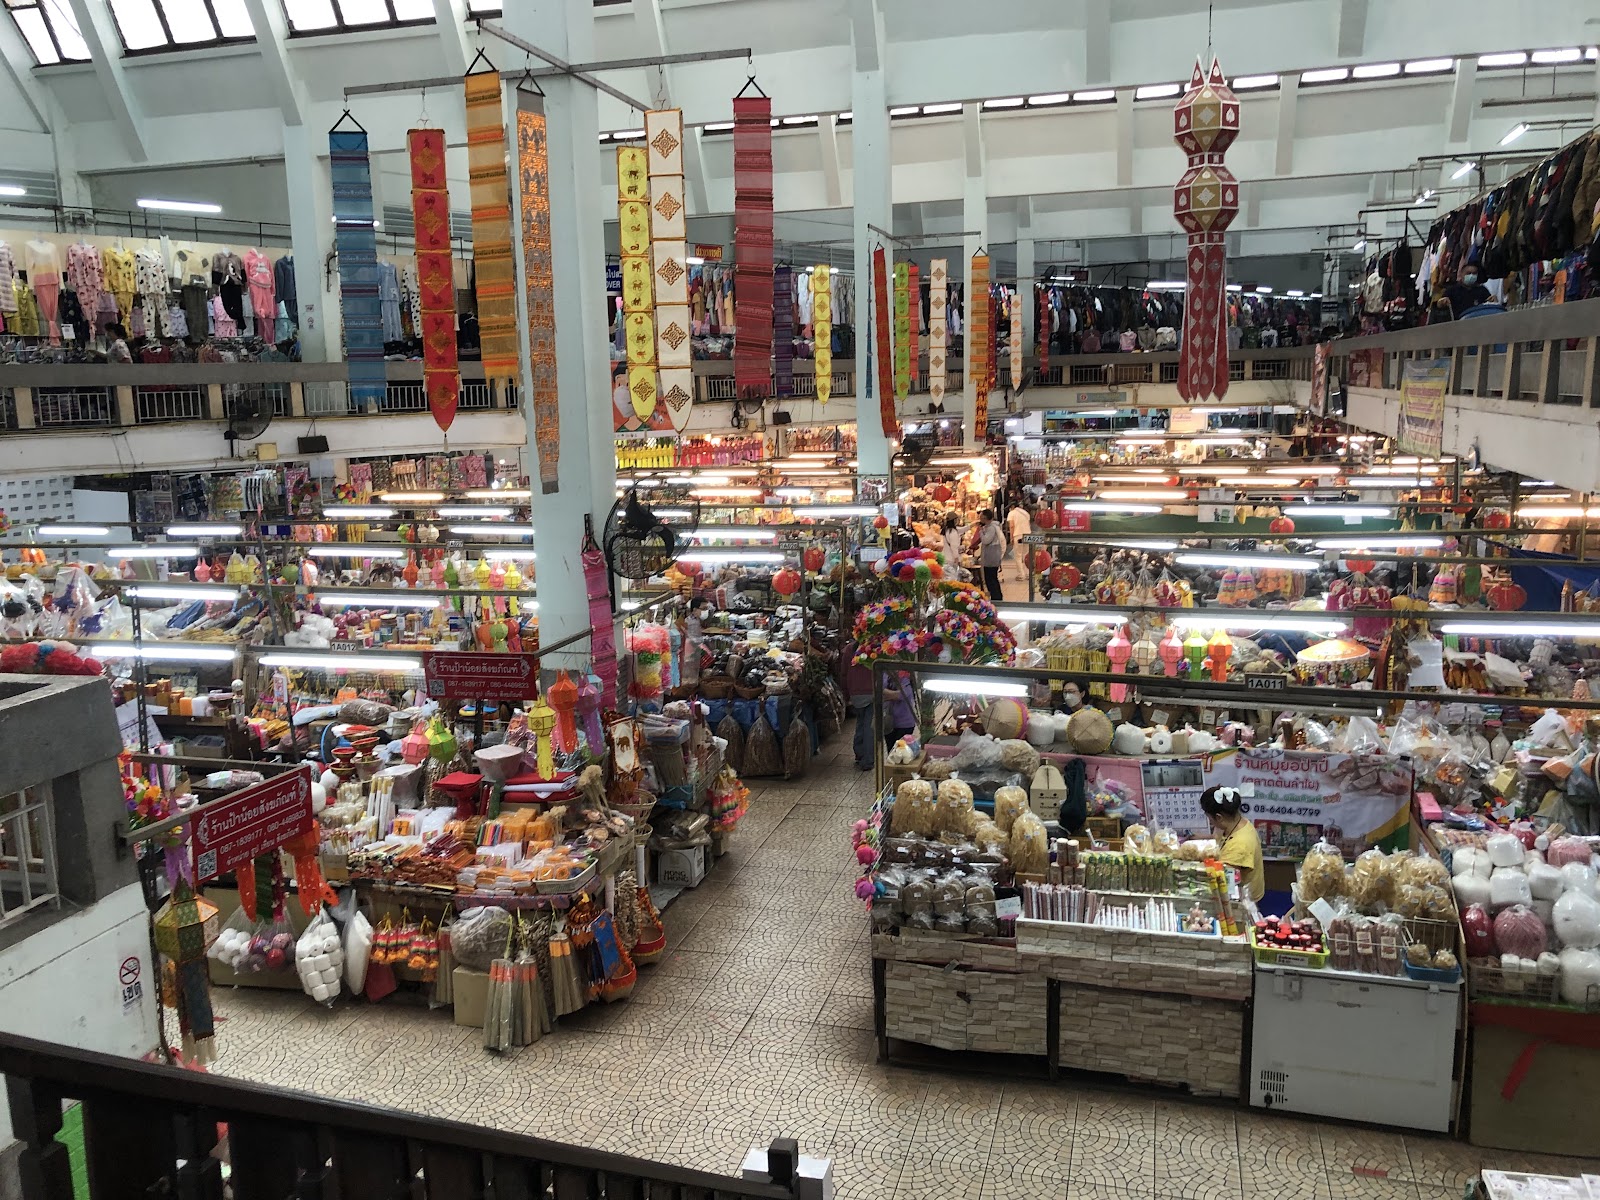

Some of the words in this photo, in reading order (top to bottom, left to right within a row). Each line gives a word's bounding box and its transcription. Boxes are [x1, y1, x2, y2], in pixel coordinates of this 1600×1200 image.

[331, 643, 356, 651] 1A012
[1248, 679, 1283, 689] 1A011
[1253, 804, 1320, 817] 08-6404-3799
[220, 828, 263, 854] 087-1839177
